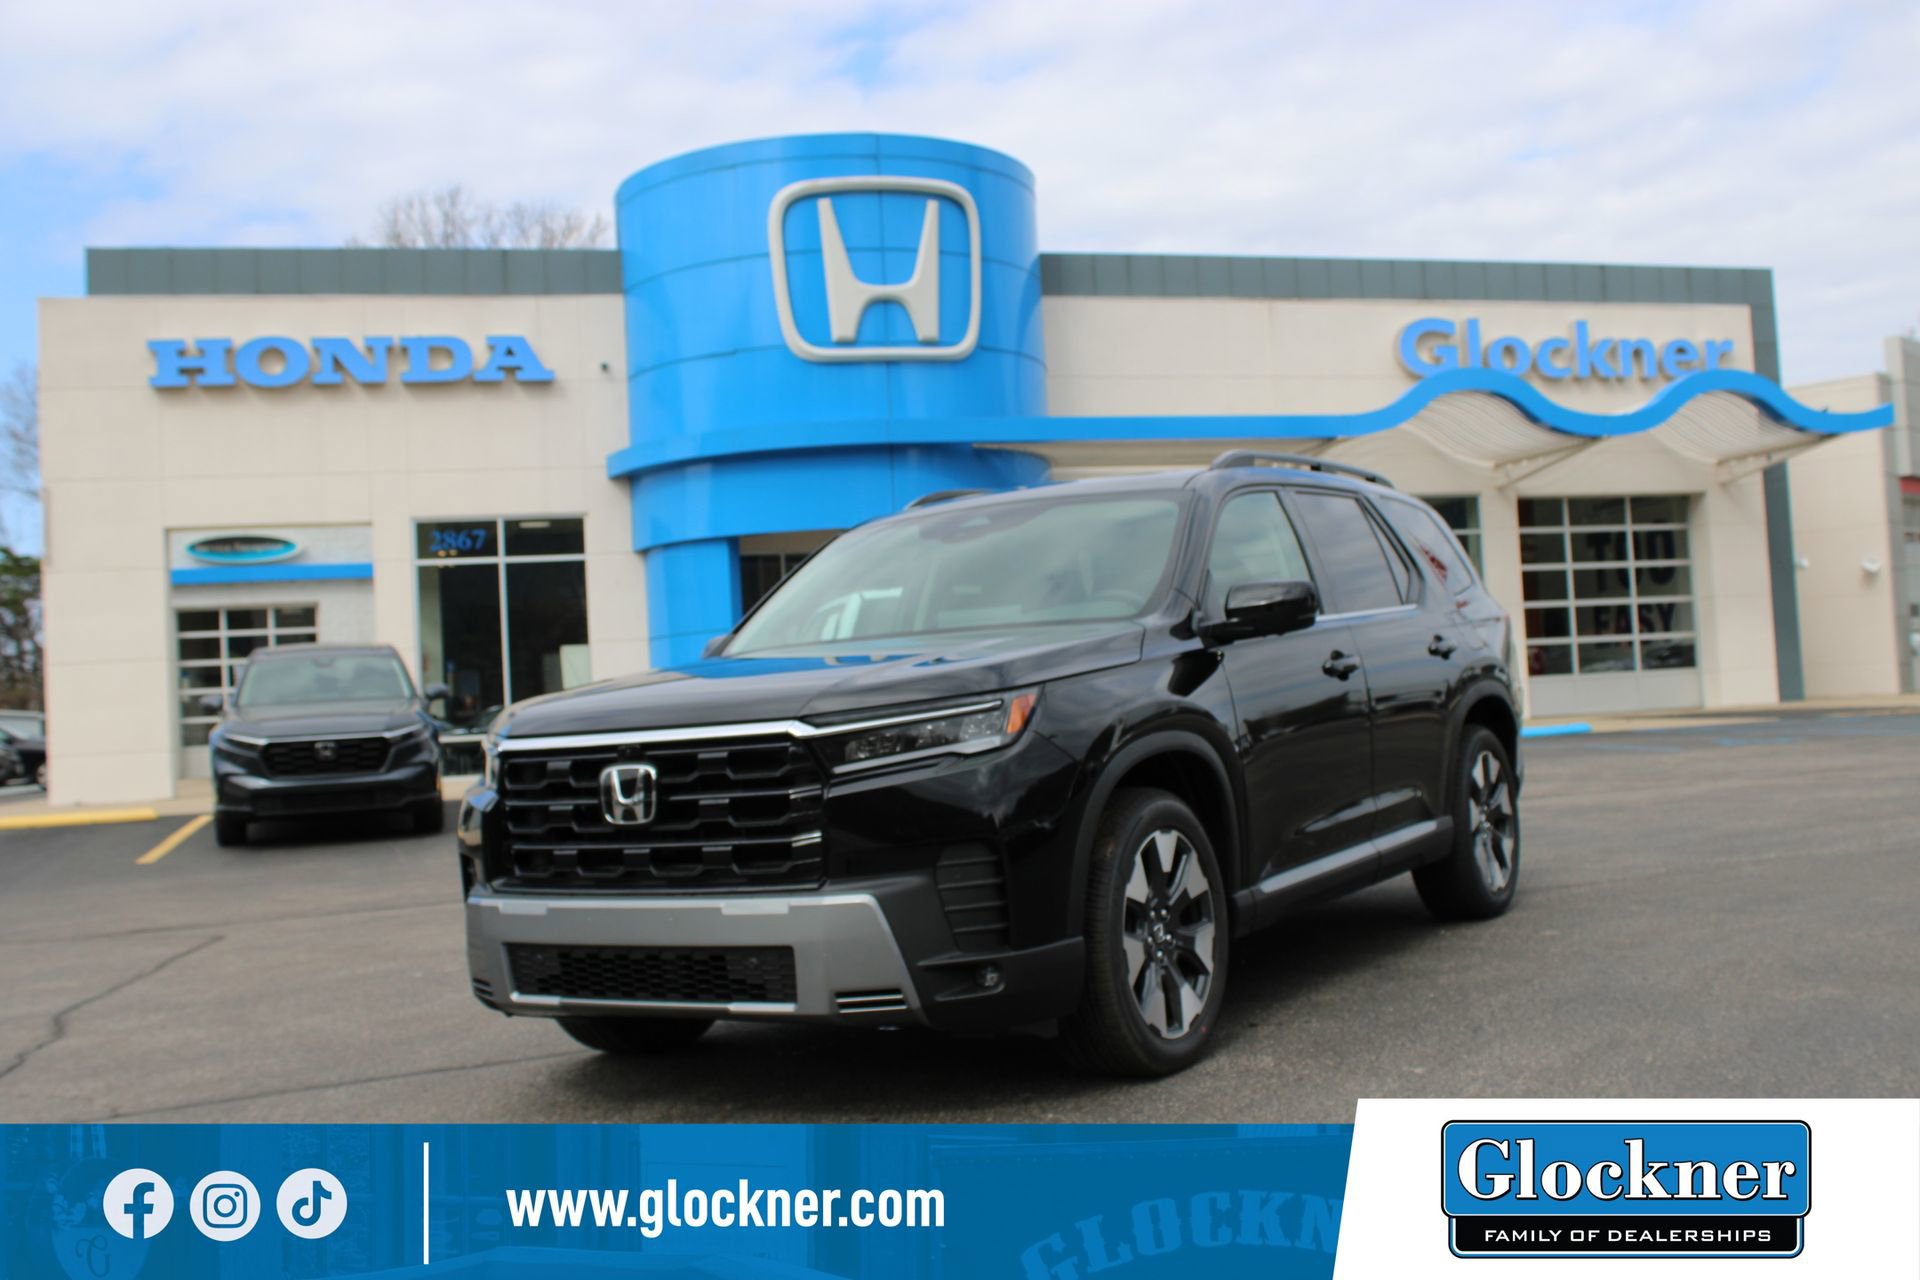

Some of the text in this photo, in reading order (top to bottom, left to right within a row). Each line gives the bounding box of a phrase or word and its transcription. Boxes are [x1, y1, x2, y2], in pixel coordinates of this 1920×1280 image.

[147, 335, 556, 388] HONDA
[1400, 317, 1735, 380] Glockner
[430, 528, 488, 552] 2867
